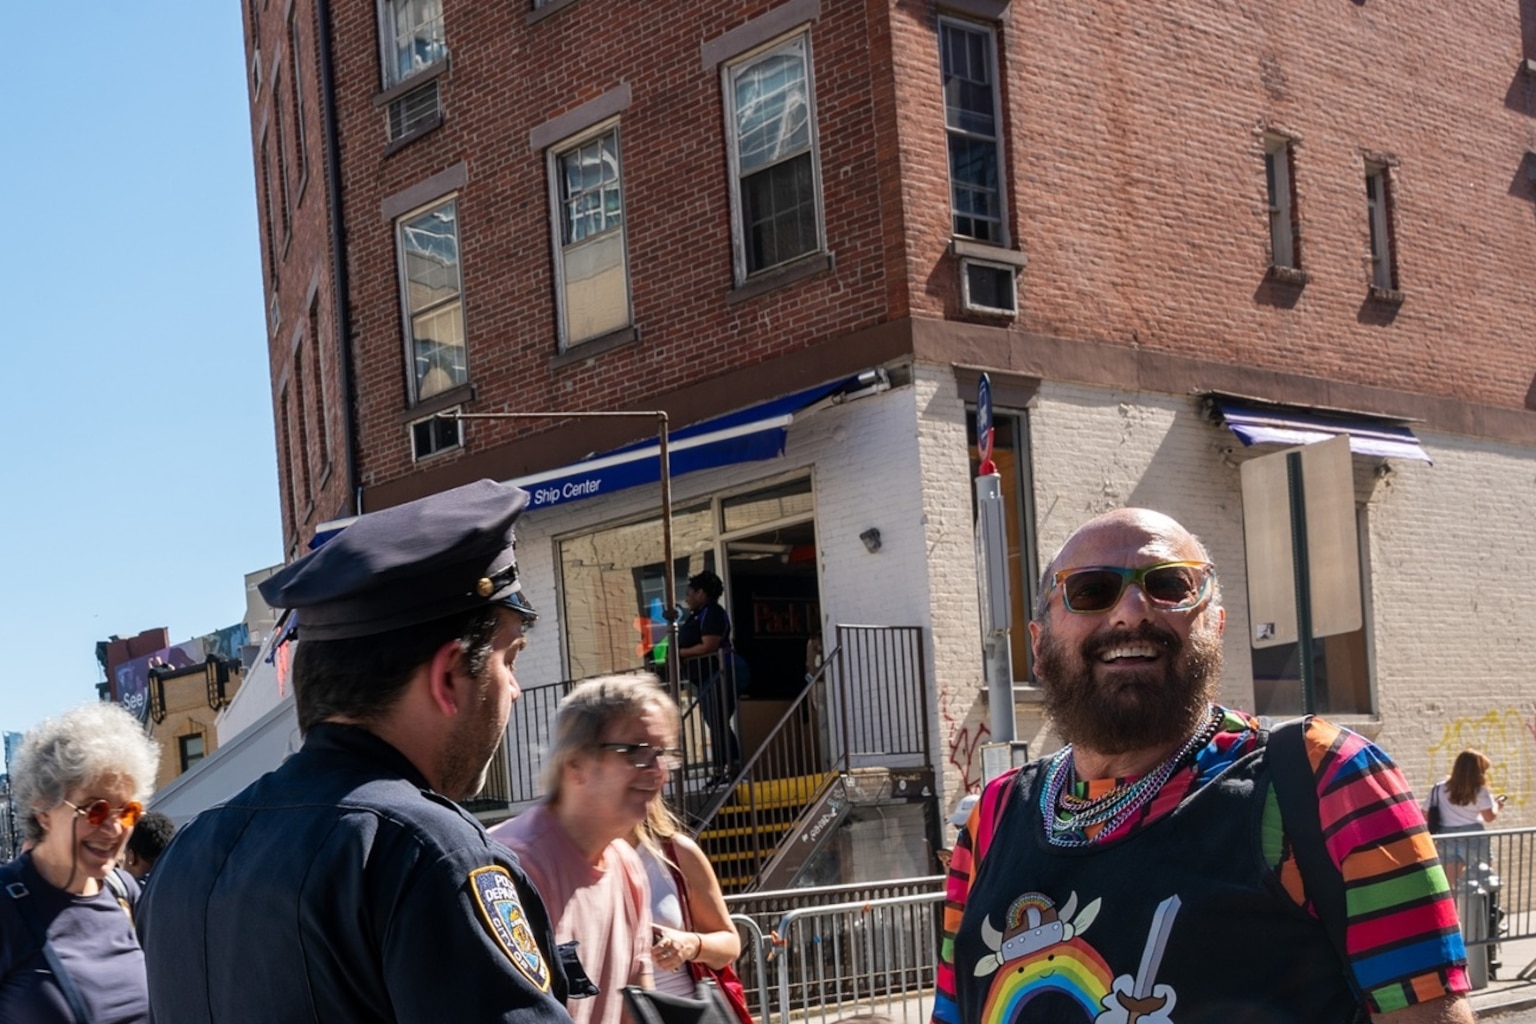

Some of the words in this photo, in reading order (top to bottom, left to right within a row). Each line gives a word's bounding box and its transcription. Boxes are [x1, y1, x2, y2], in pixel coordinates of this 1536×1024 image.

[534, 488, 561, 505] Ship
[562, 480, 602, 498] Center
[123, 692, 143, 710] See
[492, 917, 514, 948] CITY
